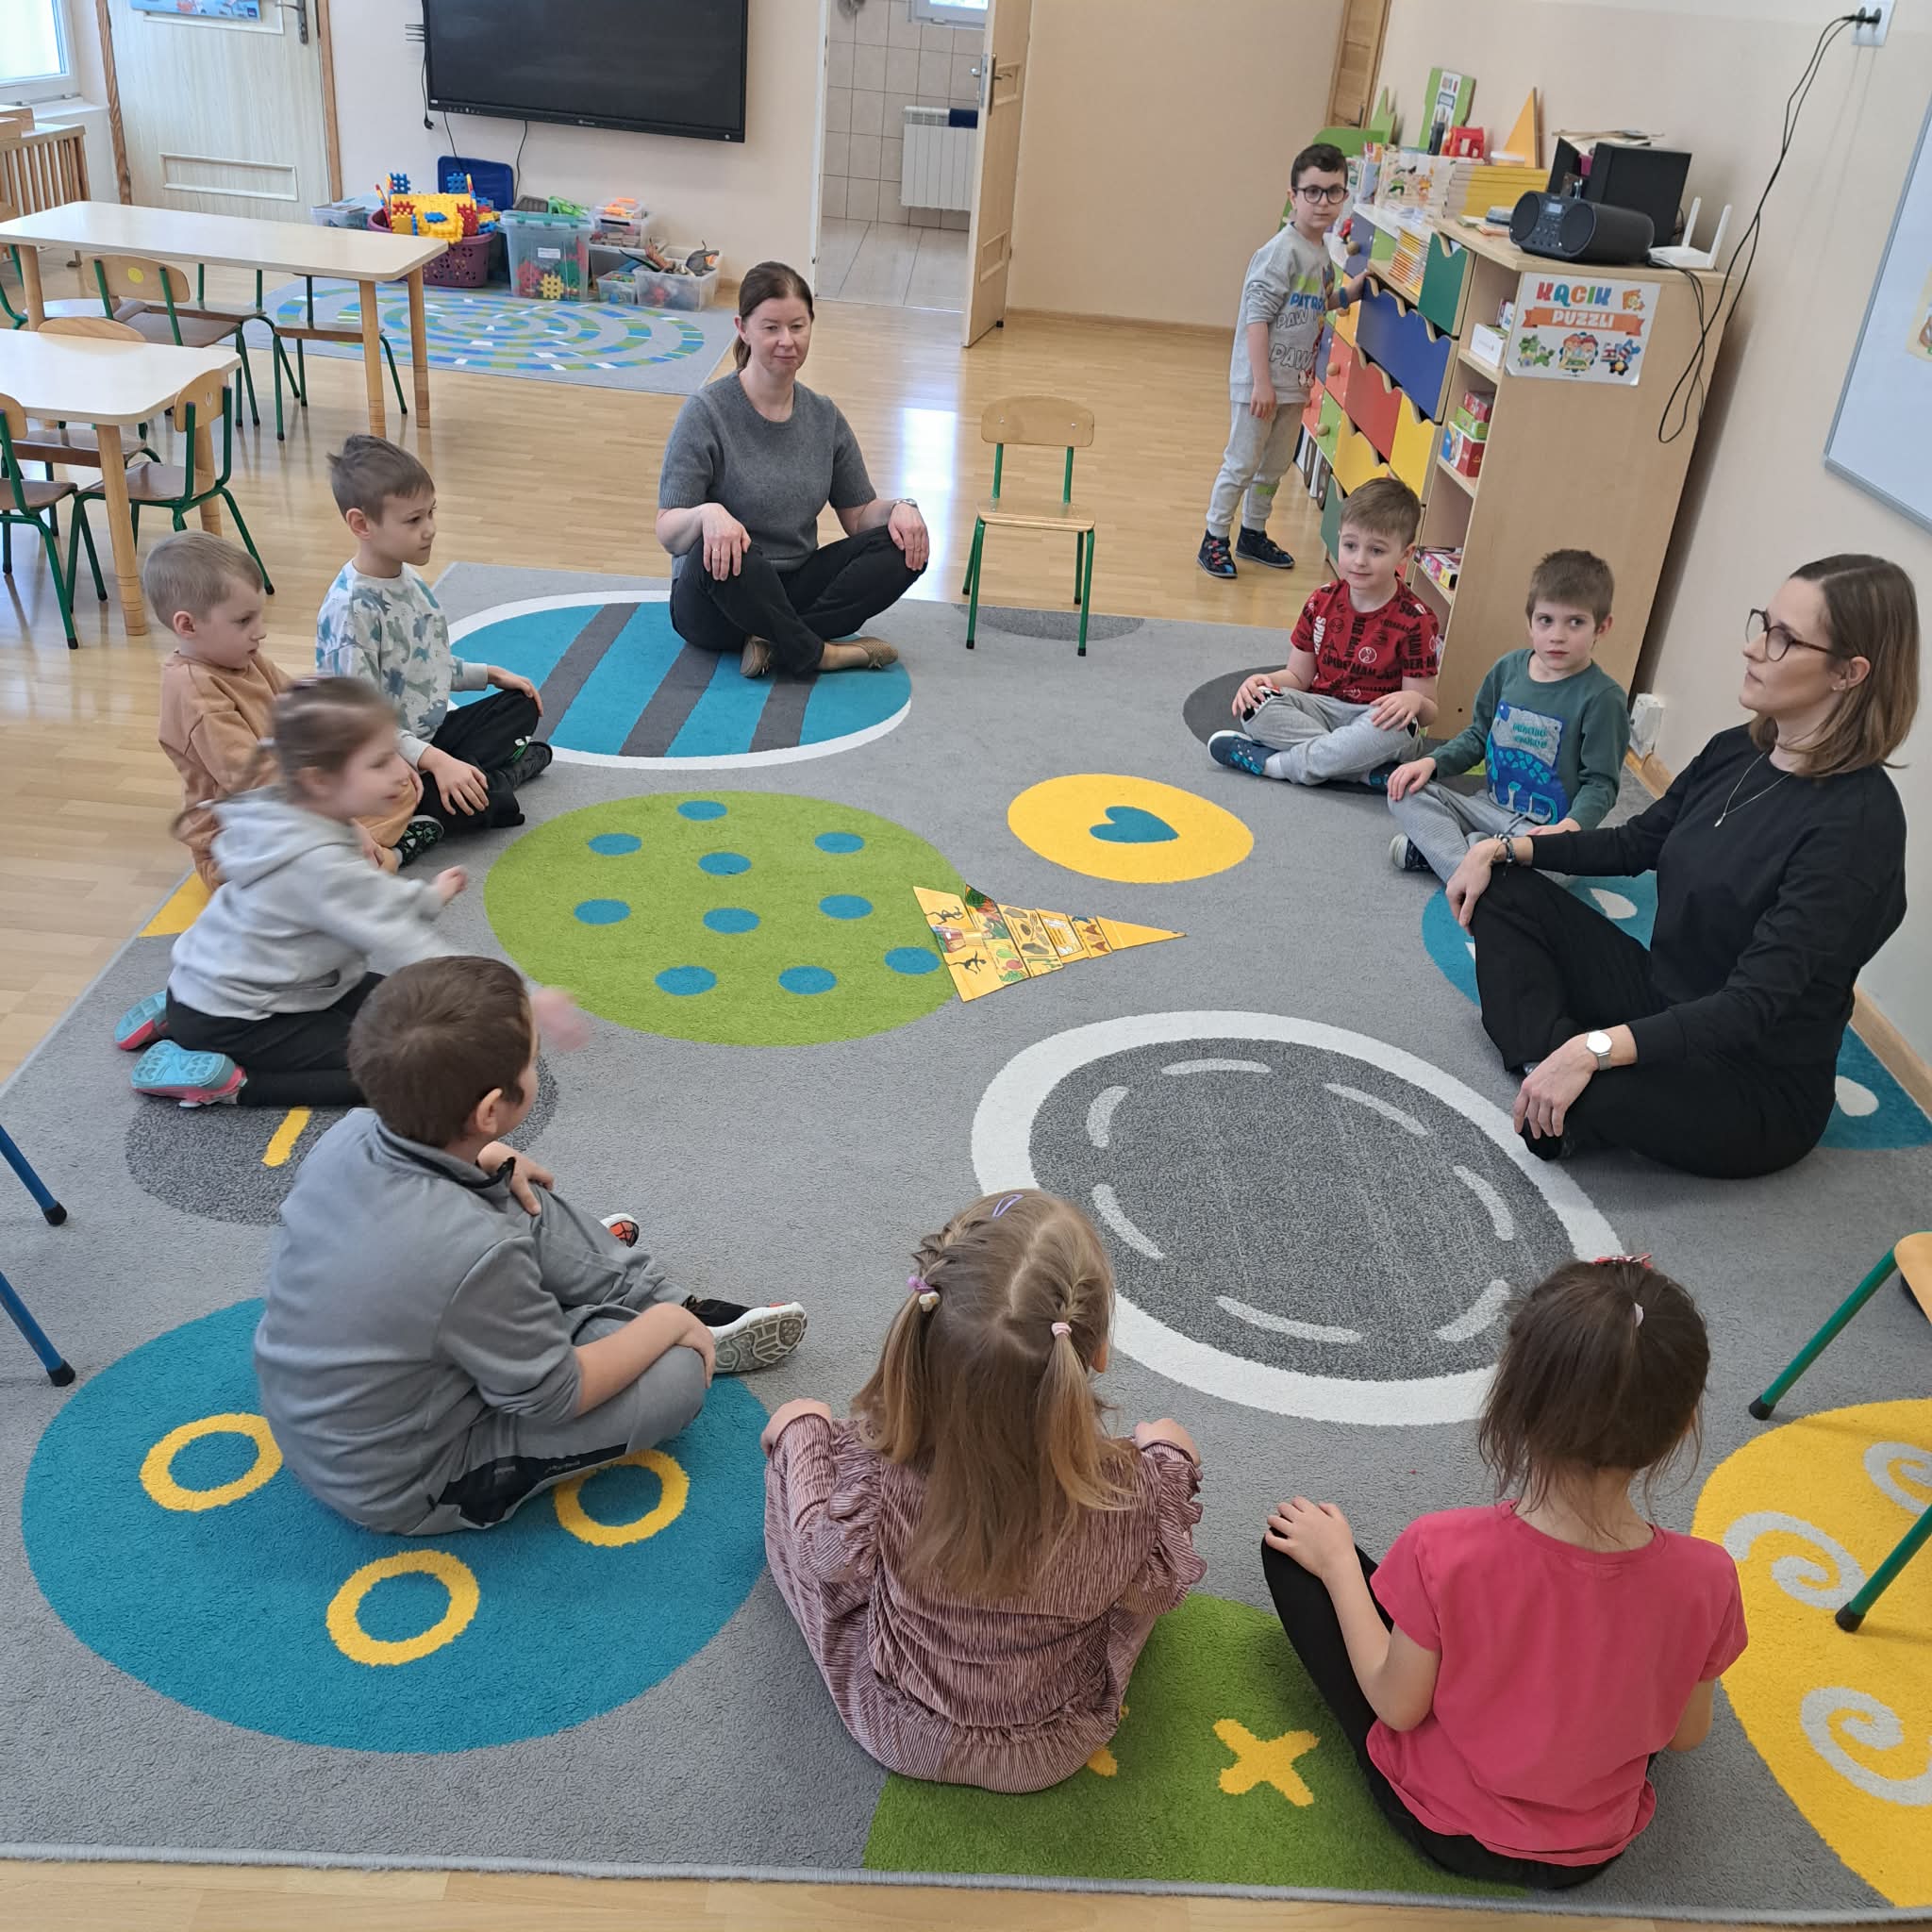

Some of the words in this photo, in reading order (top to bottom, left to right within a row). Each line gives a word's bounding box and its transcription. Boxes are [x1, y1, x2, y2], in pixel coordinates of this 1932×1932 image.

[1536, 281, 1612, 308] KĄCIK
[1275, 309, 1308, 329] PAW
[1552, 309, 1614, 328] PUZZLI
[1269, 343, 1313, 370] PAW
